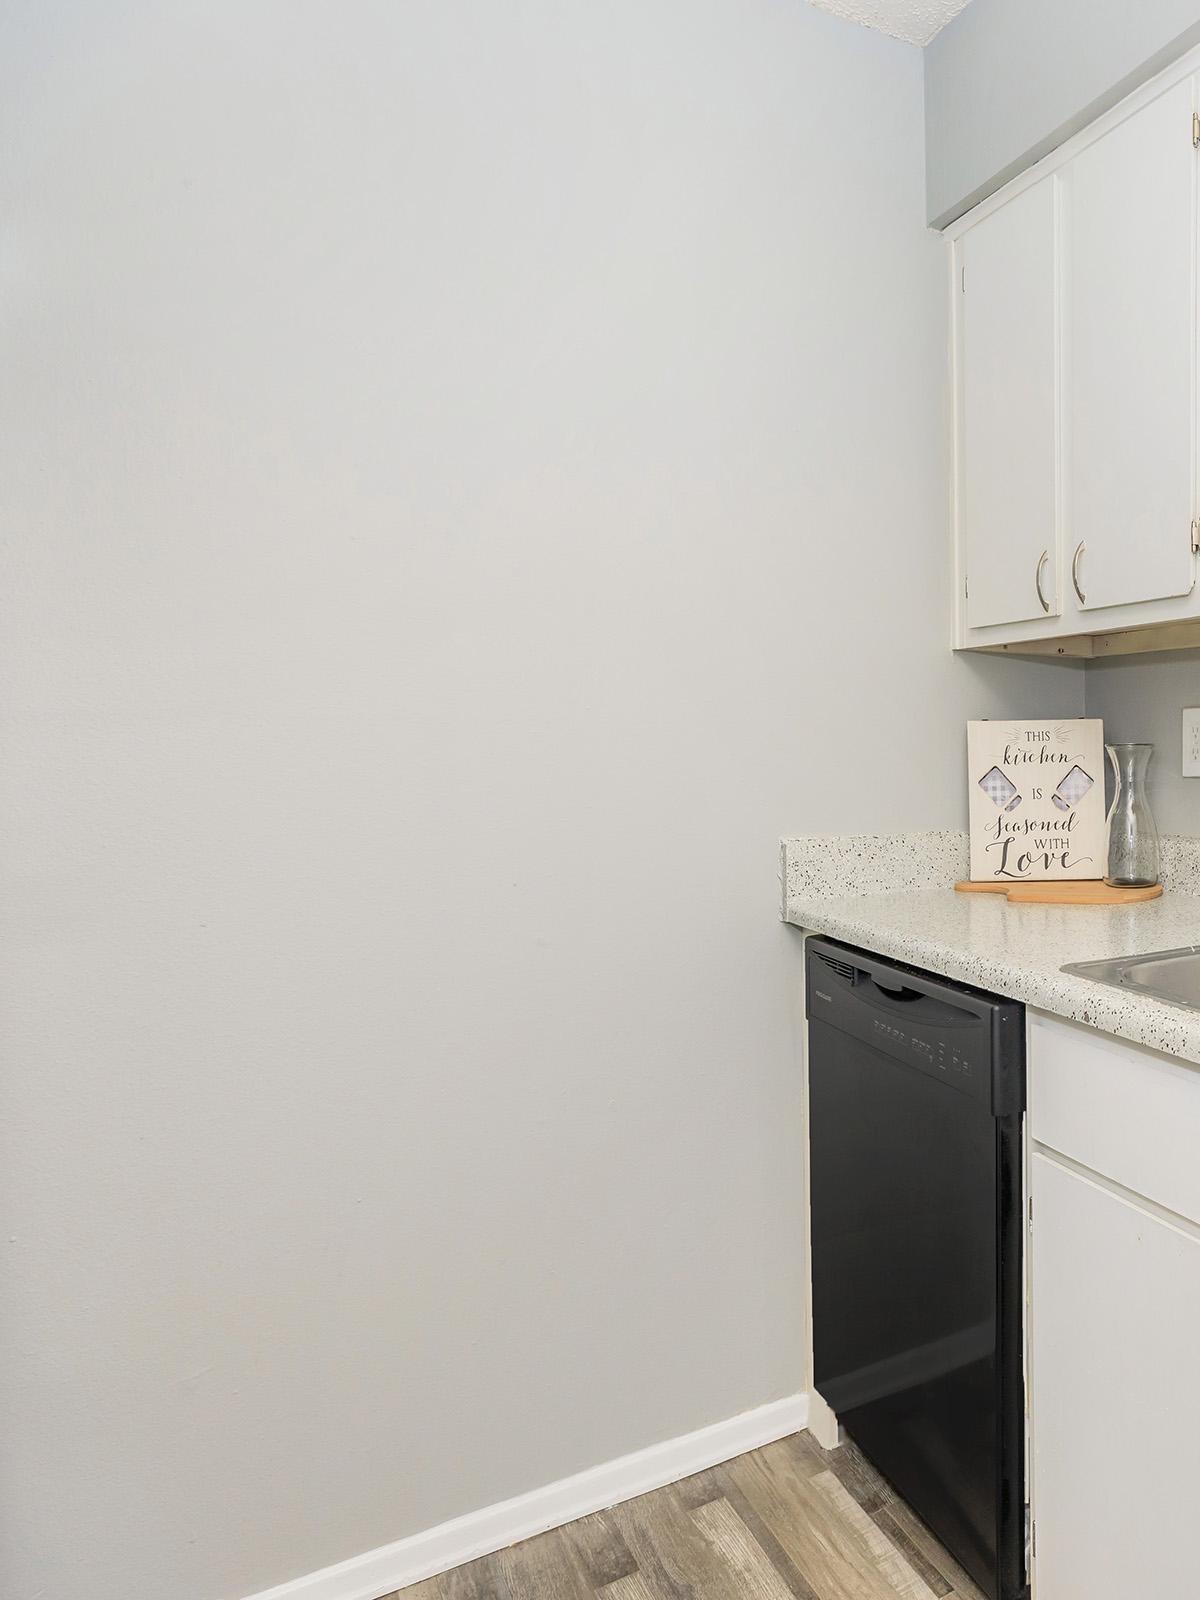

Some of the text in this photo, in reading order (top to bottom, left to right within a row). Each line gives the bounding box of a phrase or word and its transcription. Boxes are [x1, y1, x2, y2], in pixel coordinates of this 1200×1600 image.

[1024, 731, 1051, 742] THIS
[1003, 745, 1085, 765] kitchen
[1032, 788, 1043, 800] IS
[1034, 838, 1070, 849] WITH
[985, 836, 1093, 878] Love
